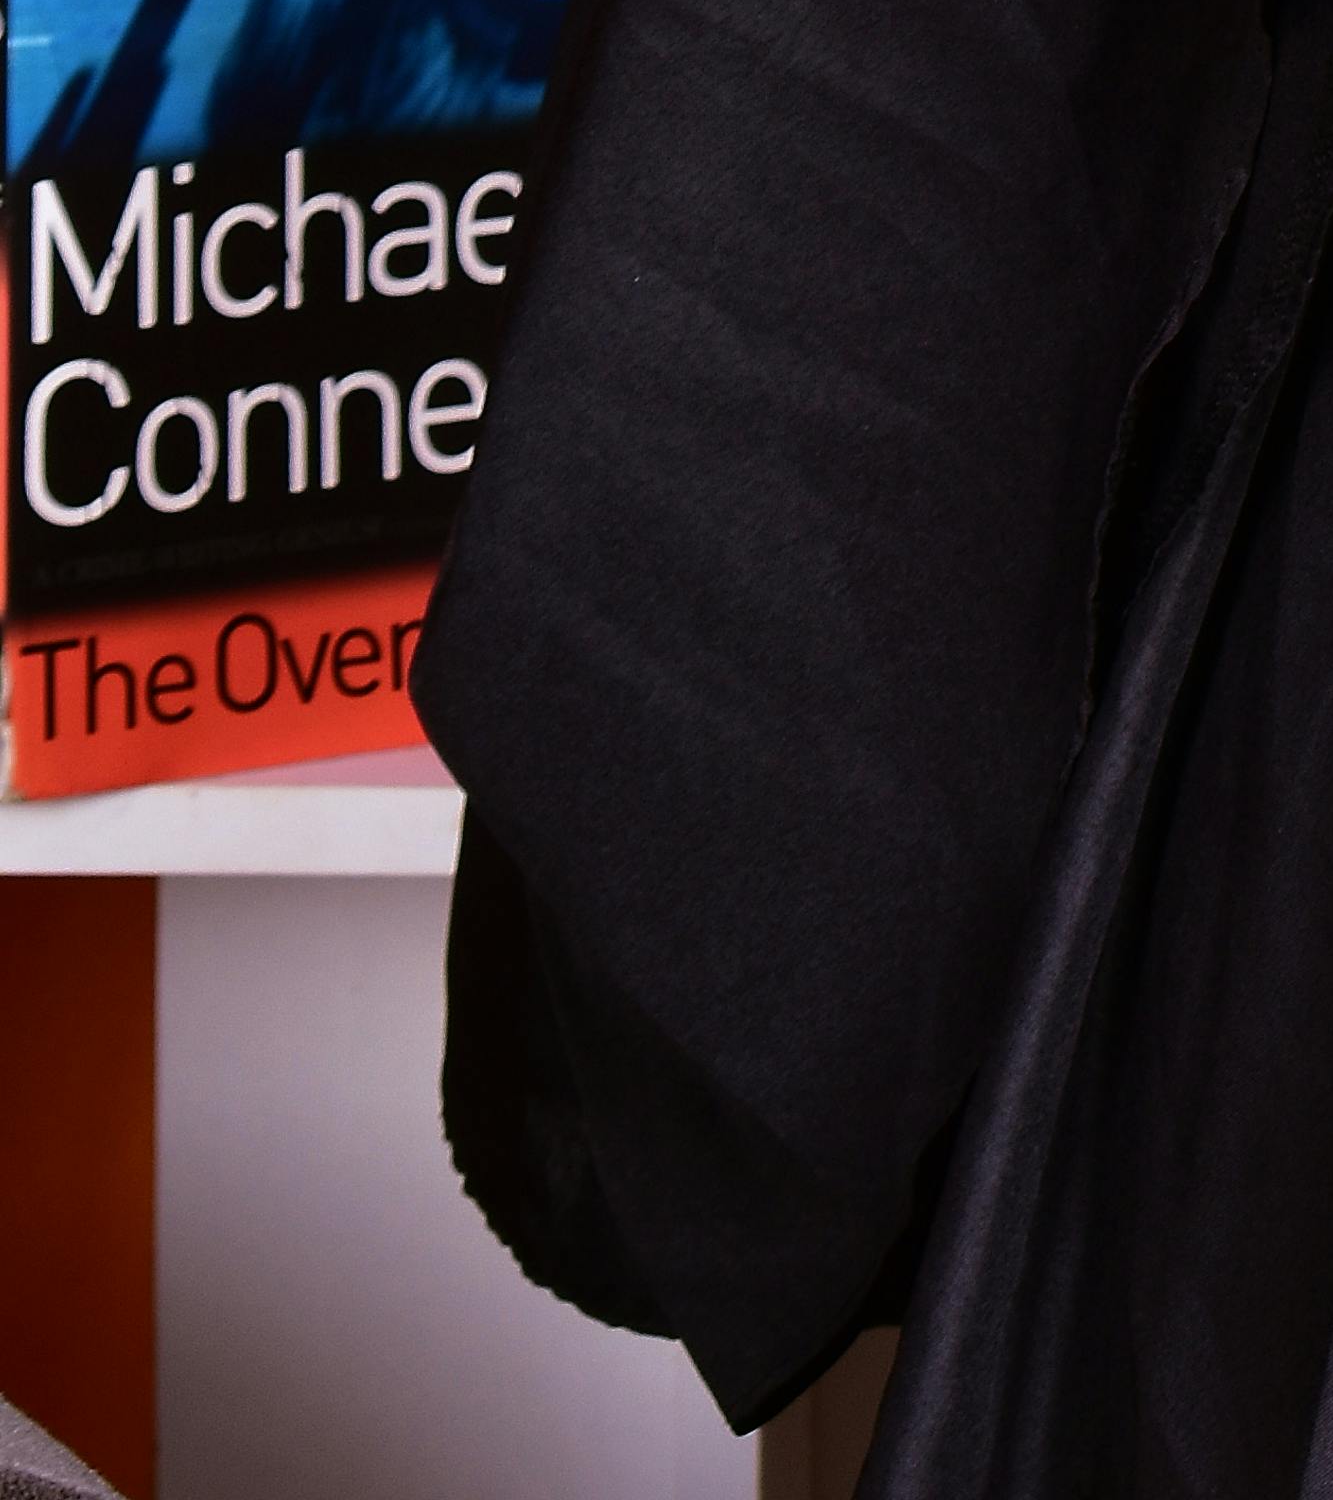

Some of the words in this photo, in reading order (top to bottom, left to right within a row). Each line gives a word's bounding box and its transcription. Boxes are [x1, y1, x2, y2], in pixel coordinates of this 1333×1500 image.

[30, 147, 524, 345] Michae
[22, 357, 489, 528] Conne
[20, 636, 198, 741] The
